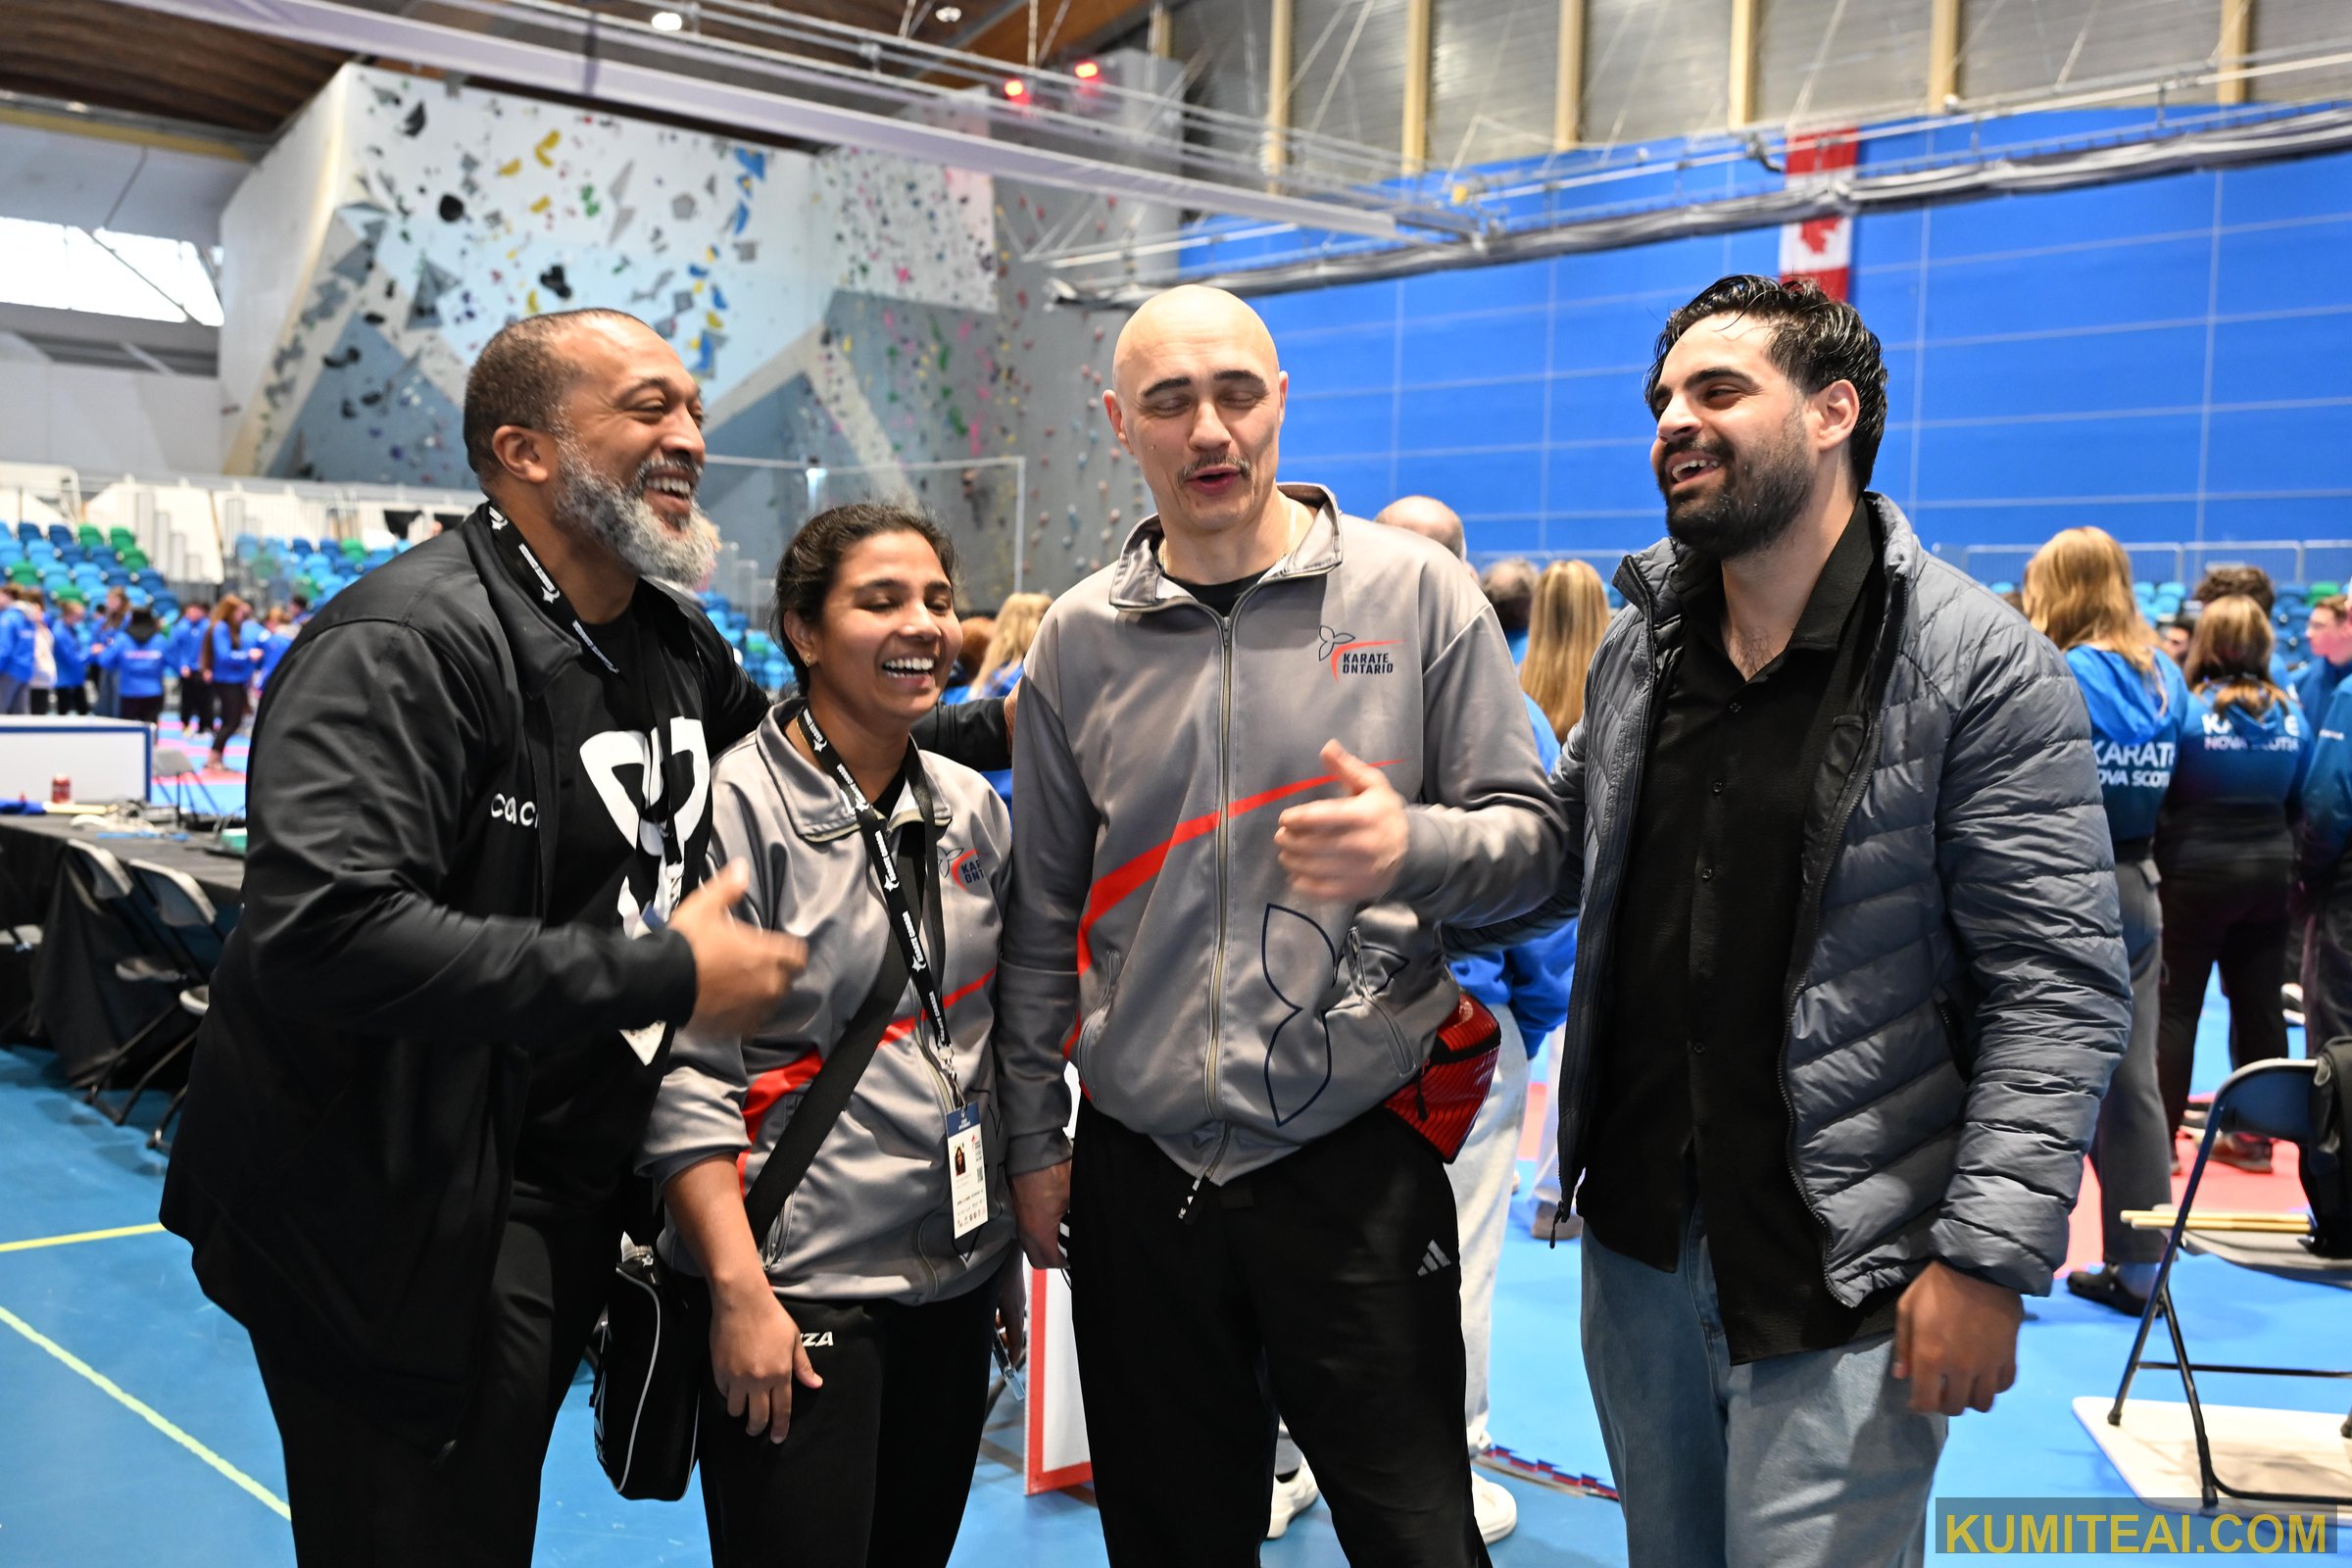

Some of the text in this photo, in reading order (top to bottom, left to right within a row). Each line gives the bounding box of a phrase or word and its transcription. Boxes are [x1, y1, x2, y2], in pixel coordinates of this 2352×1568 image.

[1343, 653, 1389, 663] KARATE
[1343, 663, 1394, 674] ONTARIO
[2097, 768, 2129, 786] OVA
[800, 1331, 834, 1347] ZA
